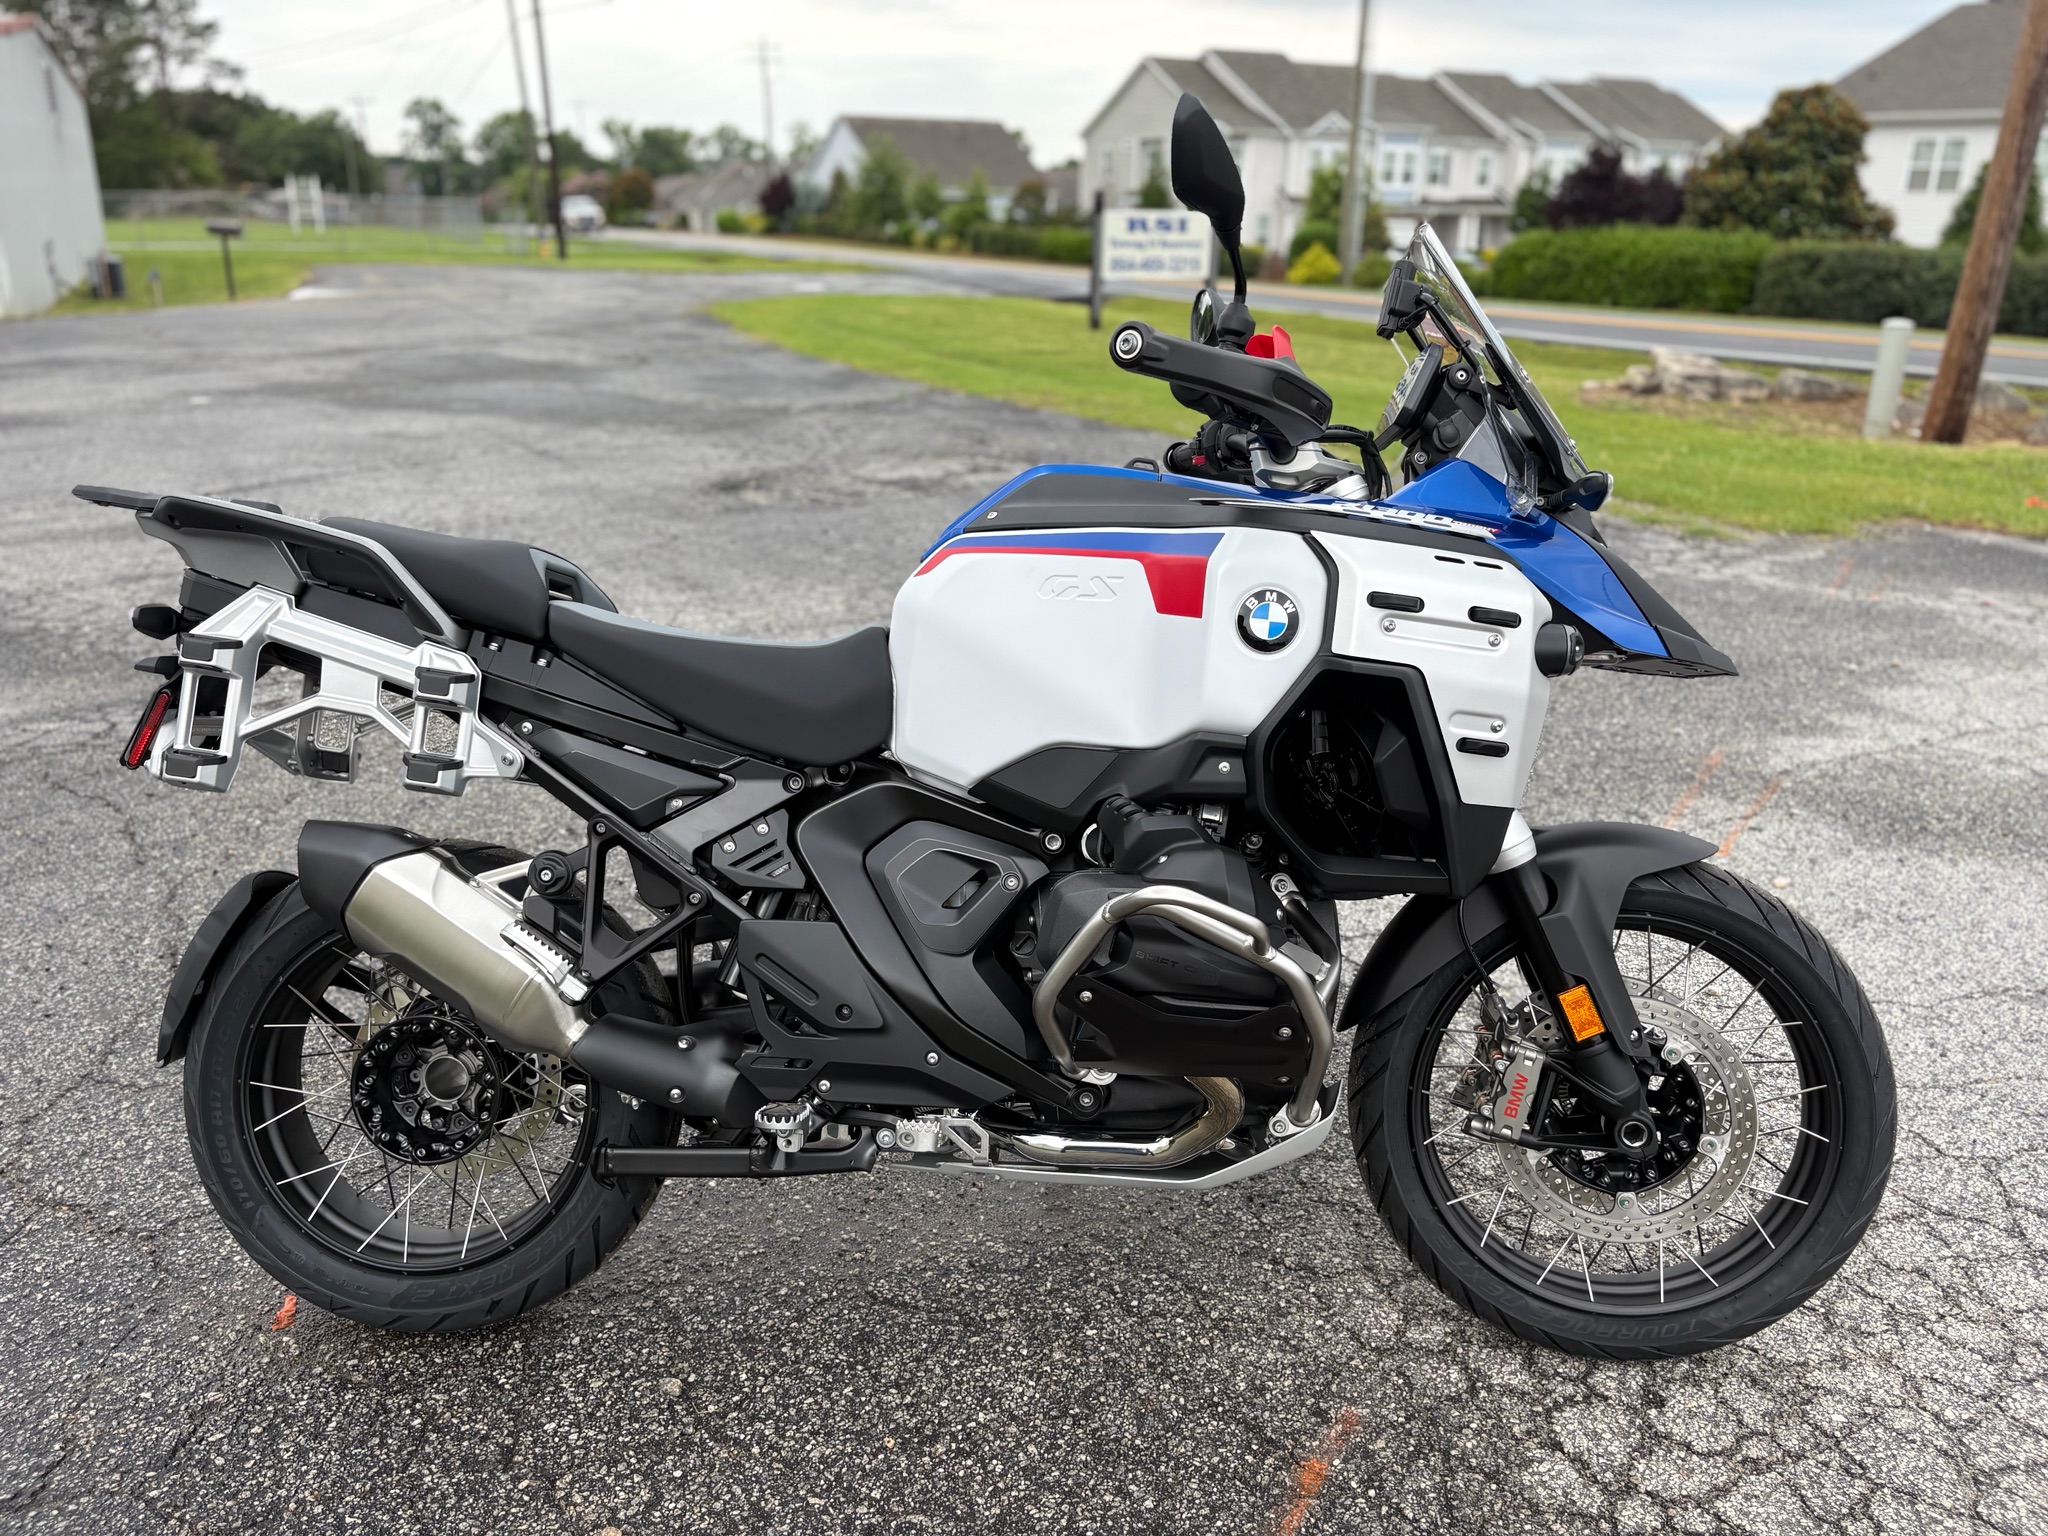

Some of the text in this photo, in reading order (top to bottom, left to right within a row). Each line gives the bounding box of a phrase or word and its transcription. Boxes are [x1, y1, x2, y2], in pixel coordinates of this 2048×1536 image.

[1037, 574, 1124, 602] GS
[1245, 591, 1296, 614] BMW
[1136, 950, 1179, 968] SHIFT
[1504, 1072, 1529, 1119] BMW
